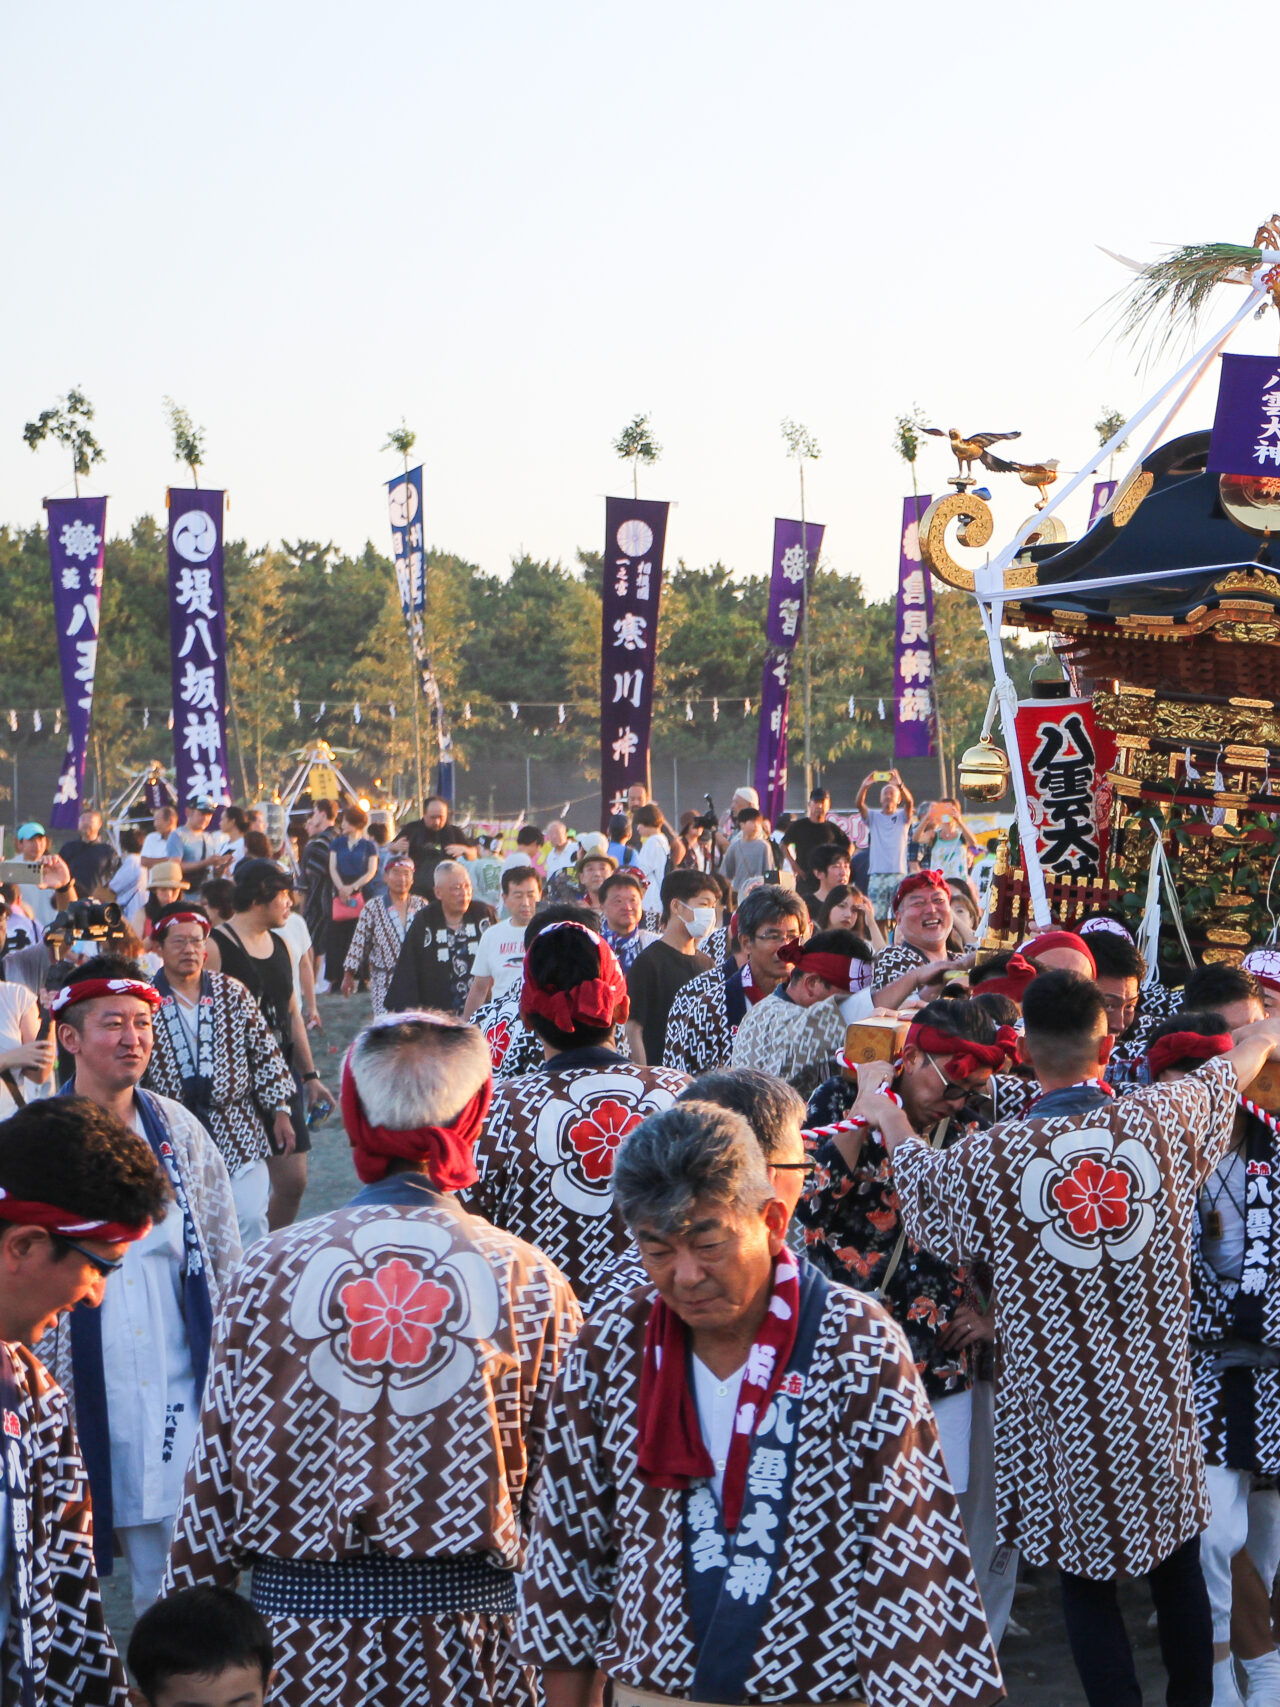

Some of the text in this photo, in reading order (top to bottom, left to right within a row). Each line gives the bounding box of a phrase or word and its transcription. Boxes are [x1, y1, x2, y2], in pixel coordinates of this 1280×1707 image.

[175, 567, 232, 808] 堤八坂神社
[1240, 1176, 1273, 1297] 八雲大神
[1246, 1159, 1271, 1175] 上赤
[725, 1395, 795, 1605] 八雲大神
